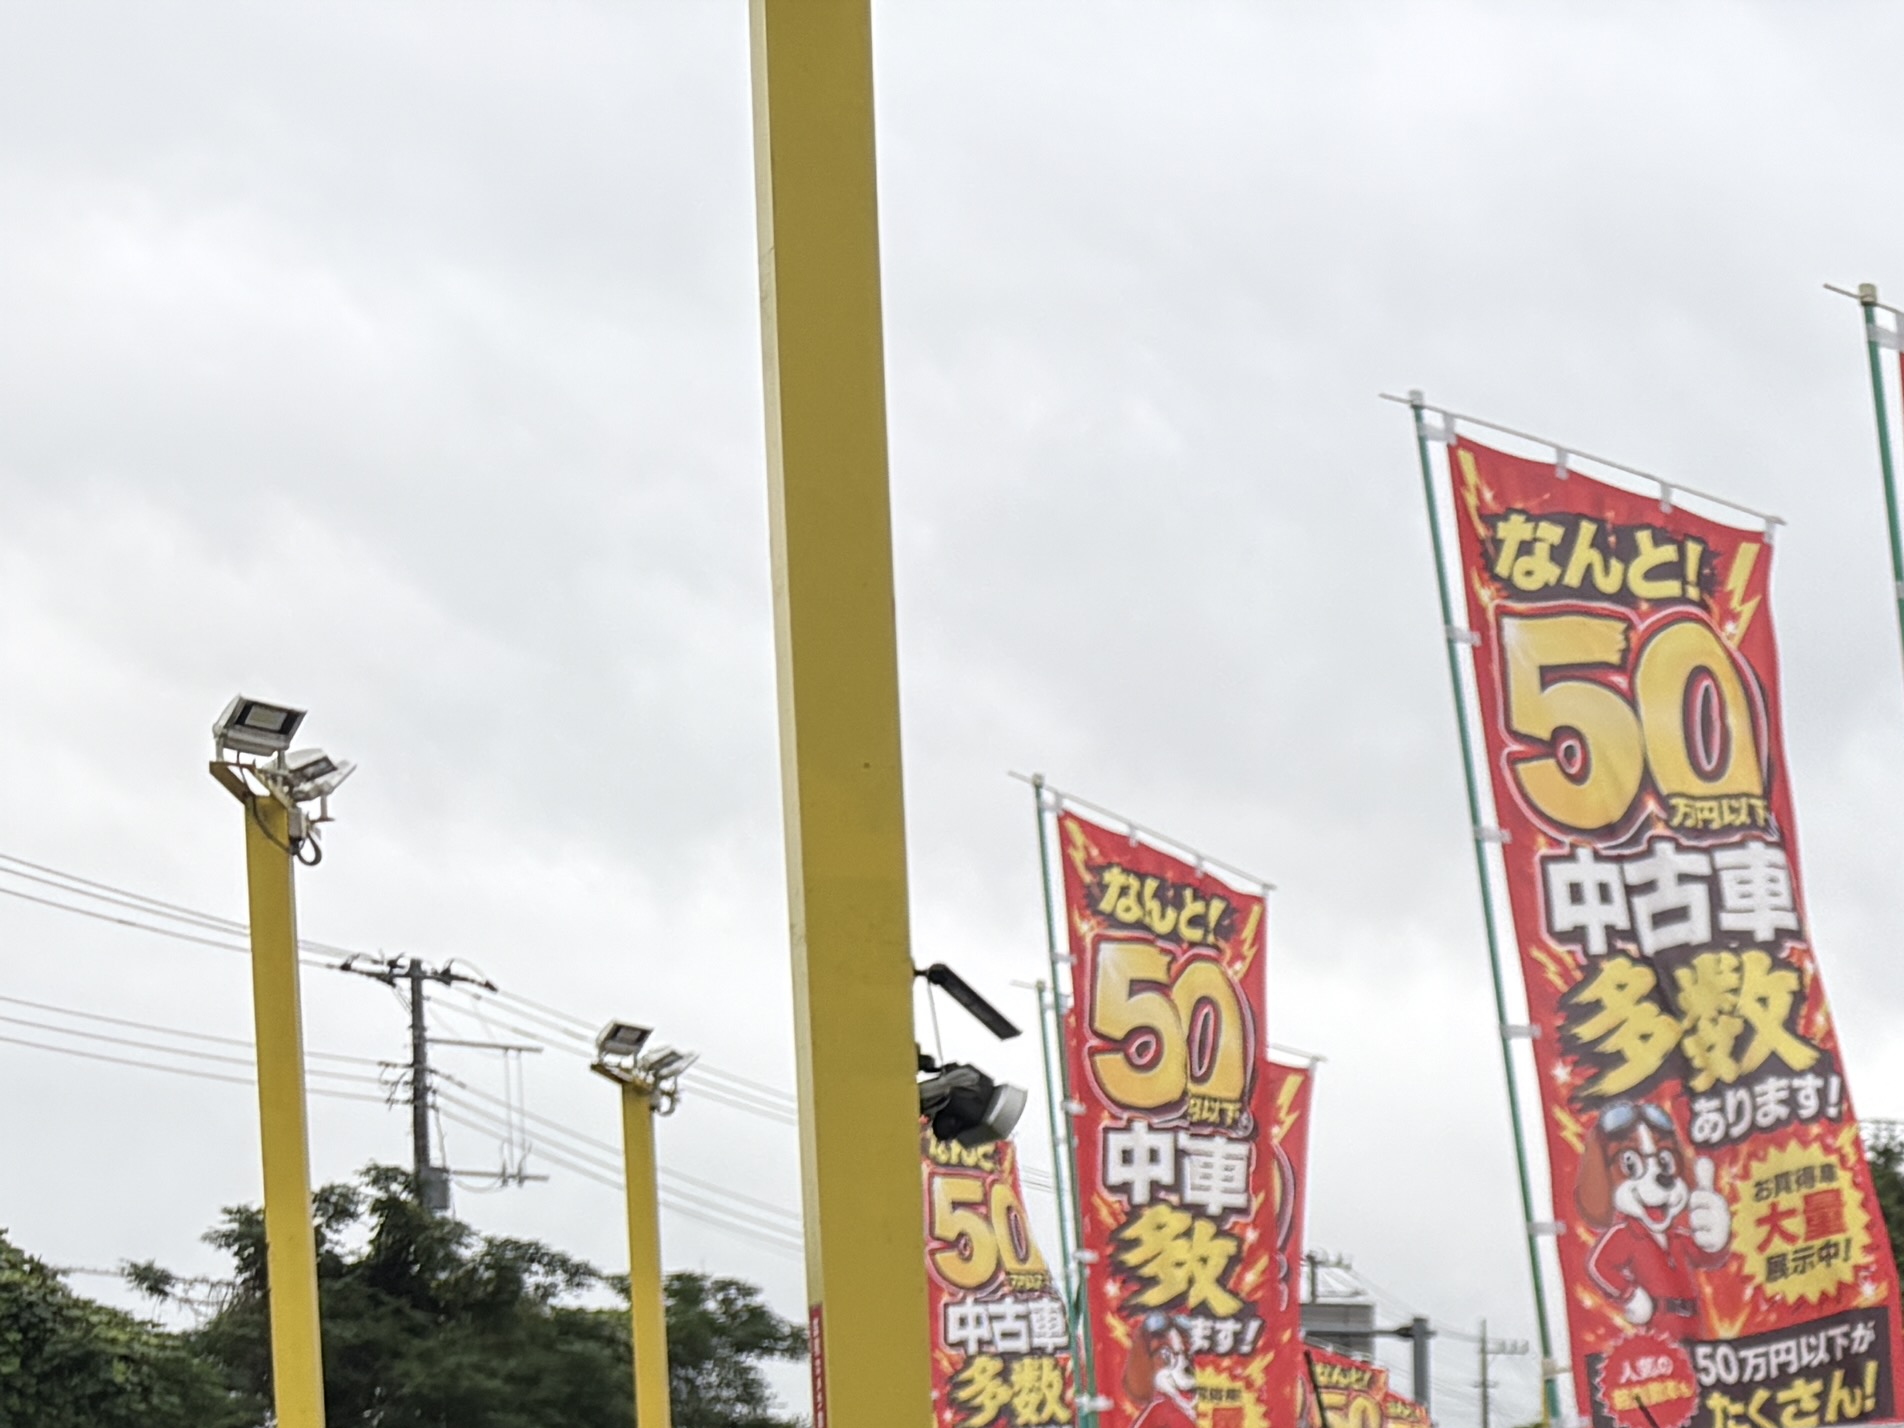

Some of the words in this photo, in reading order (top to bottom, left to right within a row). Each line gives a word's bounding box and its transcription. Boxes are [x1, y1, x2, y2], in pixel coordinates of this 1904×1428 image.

[1495, 514, 1705, 600] なんと!
[1502, 613, 1764, 830] 50
[1100, 866, 1225, 945] なんと!
[1545, 838, 1800, 956] 中古車
[1094, 941, 1246, 1109] 50
[1569, 948, 1821, 1099] 多数
[1690, 1075, 1844, 1145] あります!
[933, 1176, 1045, 1290] 50
[1756, 1189, 1849, 1251] 大量
[1765, 1238, 1852, 1285] 展示中!
[948, 1297, 1069, 1356] 中古車
[1697, 1318, 1877, 1387] 50万円以下が
[953, 1353, 1072, 1428] 多数
